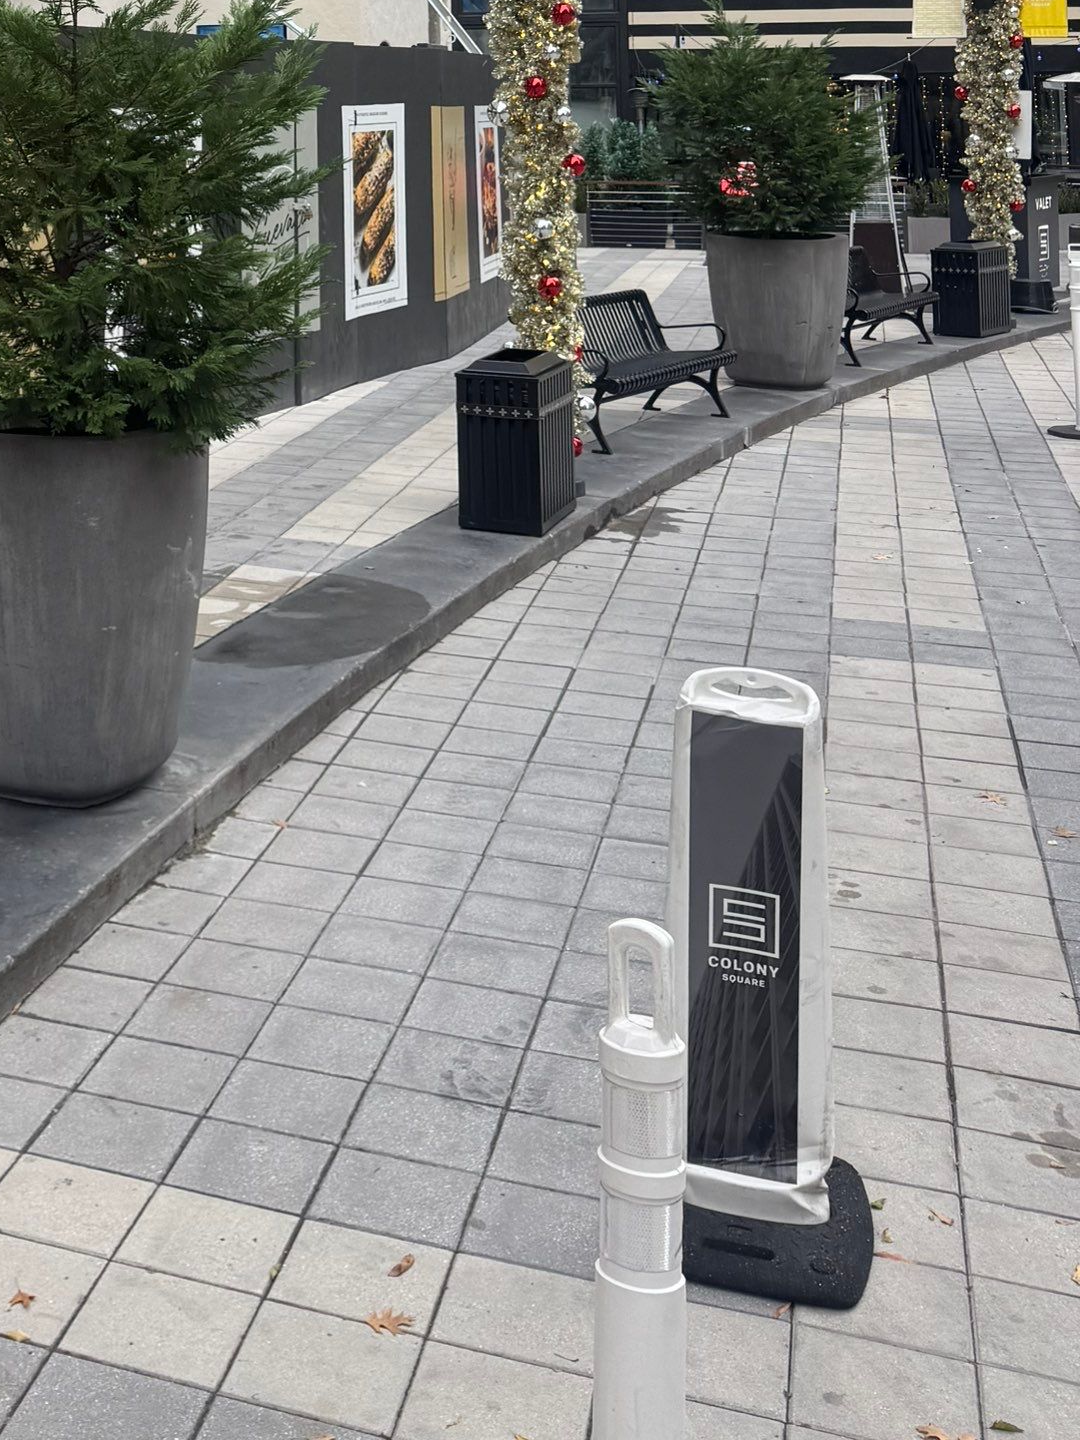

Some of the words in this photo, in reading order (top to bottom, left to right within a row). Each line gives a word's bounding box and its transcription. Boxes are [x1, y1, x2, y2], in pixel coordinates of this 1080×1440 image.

[1034, 195, 1053, 211] VALET
[708, 955, 780, 978] COLONY
[722, 973, 766, 988] SQUARE
